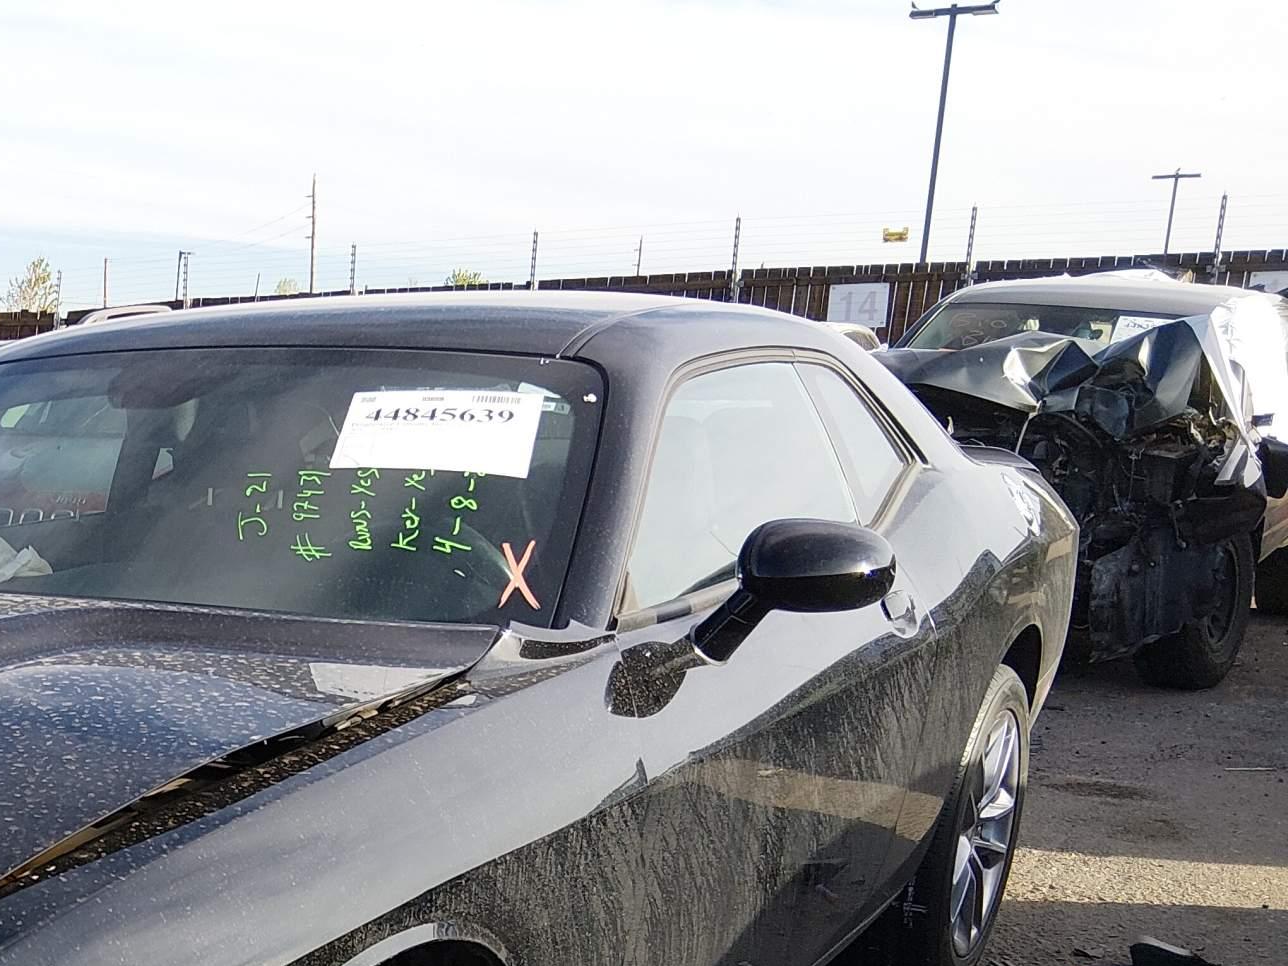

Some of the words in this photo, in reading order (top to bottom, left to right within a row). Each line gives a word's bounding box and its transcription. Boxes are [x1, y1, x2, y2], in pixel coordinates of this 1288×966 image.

[839, 290, 878, 321] 14
[365, 407, 515, 423] 44845639
[292, 470, 332, 522] 97431
